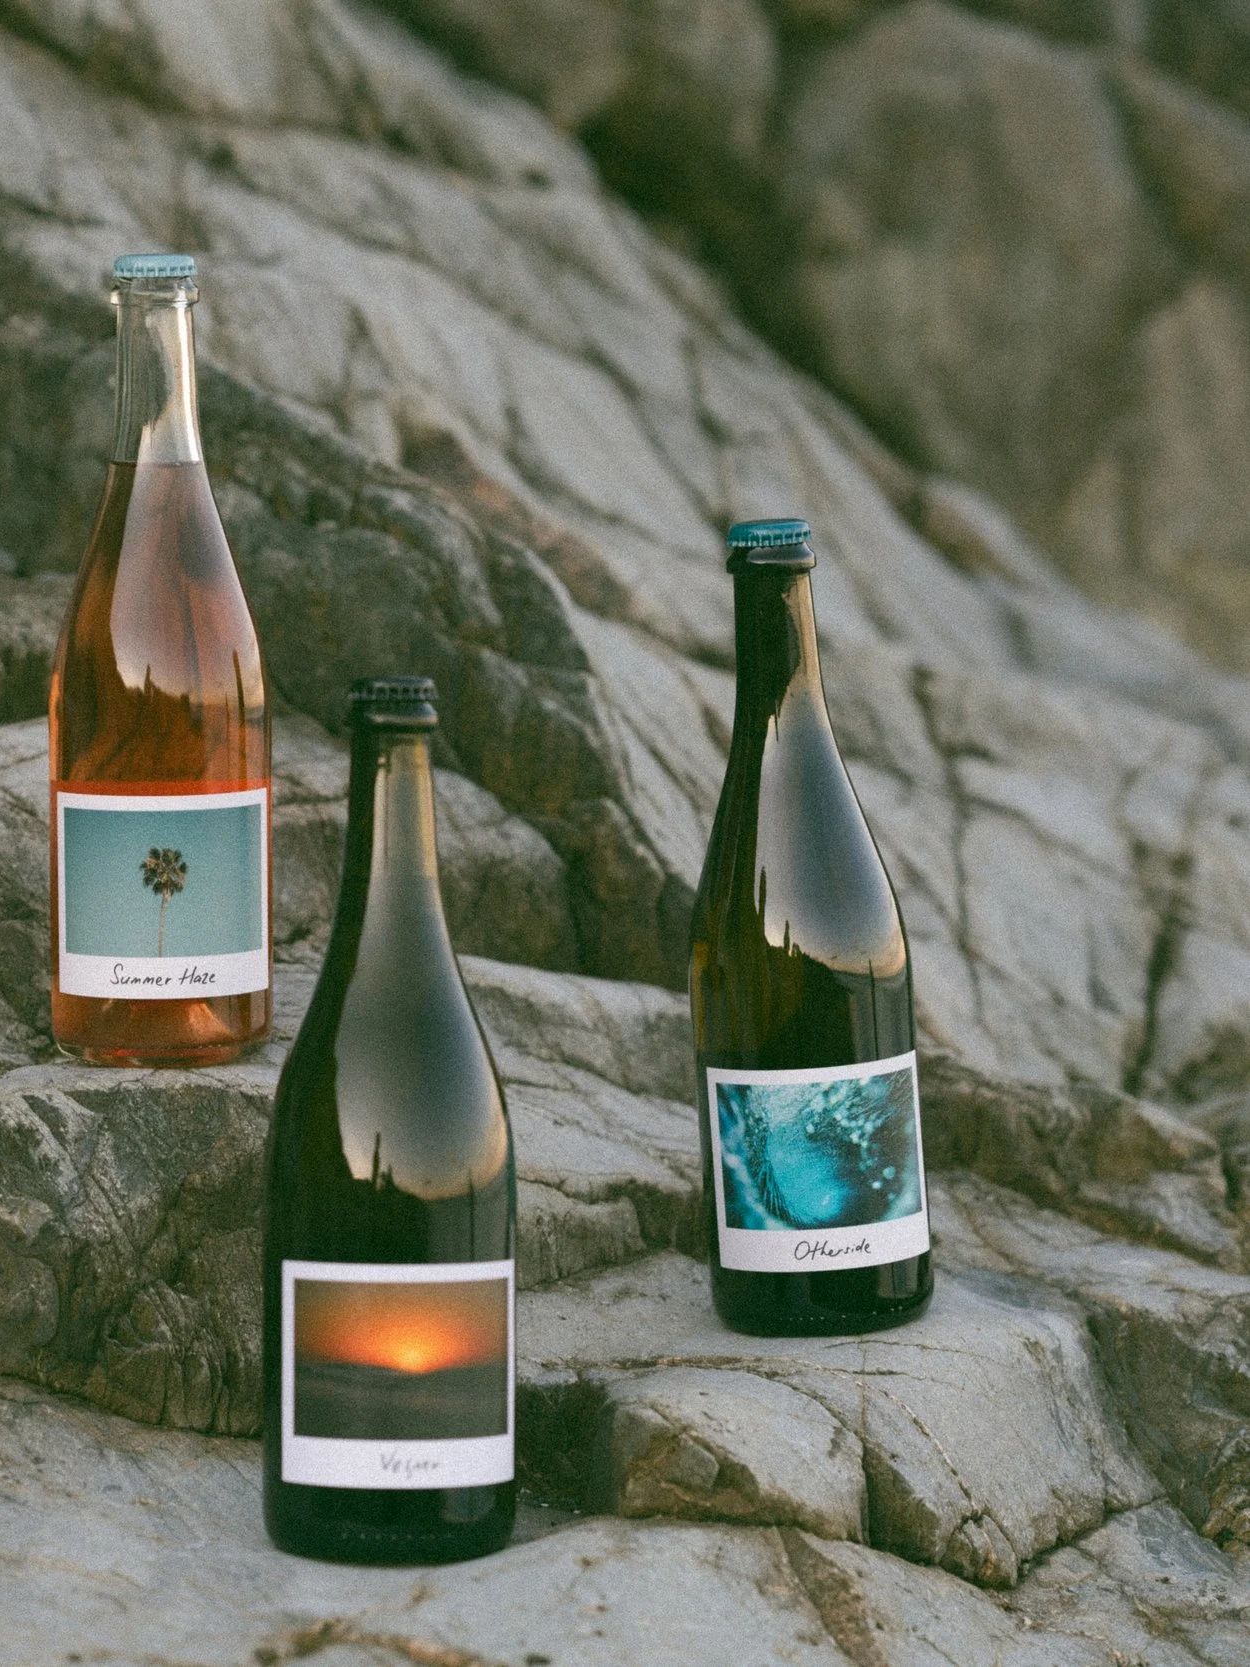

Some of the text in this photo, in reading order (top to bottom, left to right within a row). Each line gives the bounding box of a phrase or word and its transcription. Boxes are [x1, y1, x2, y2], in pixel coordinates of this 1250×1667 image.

[110, 963, 216, 986] Summer Haze
[794, 1238, 872, 1260] Otherside
